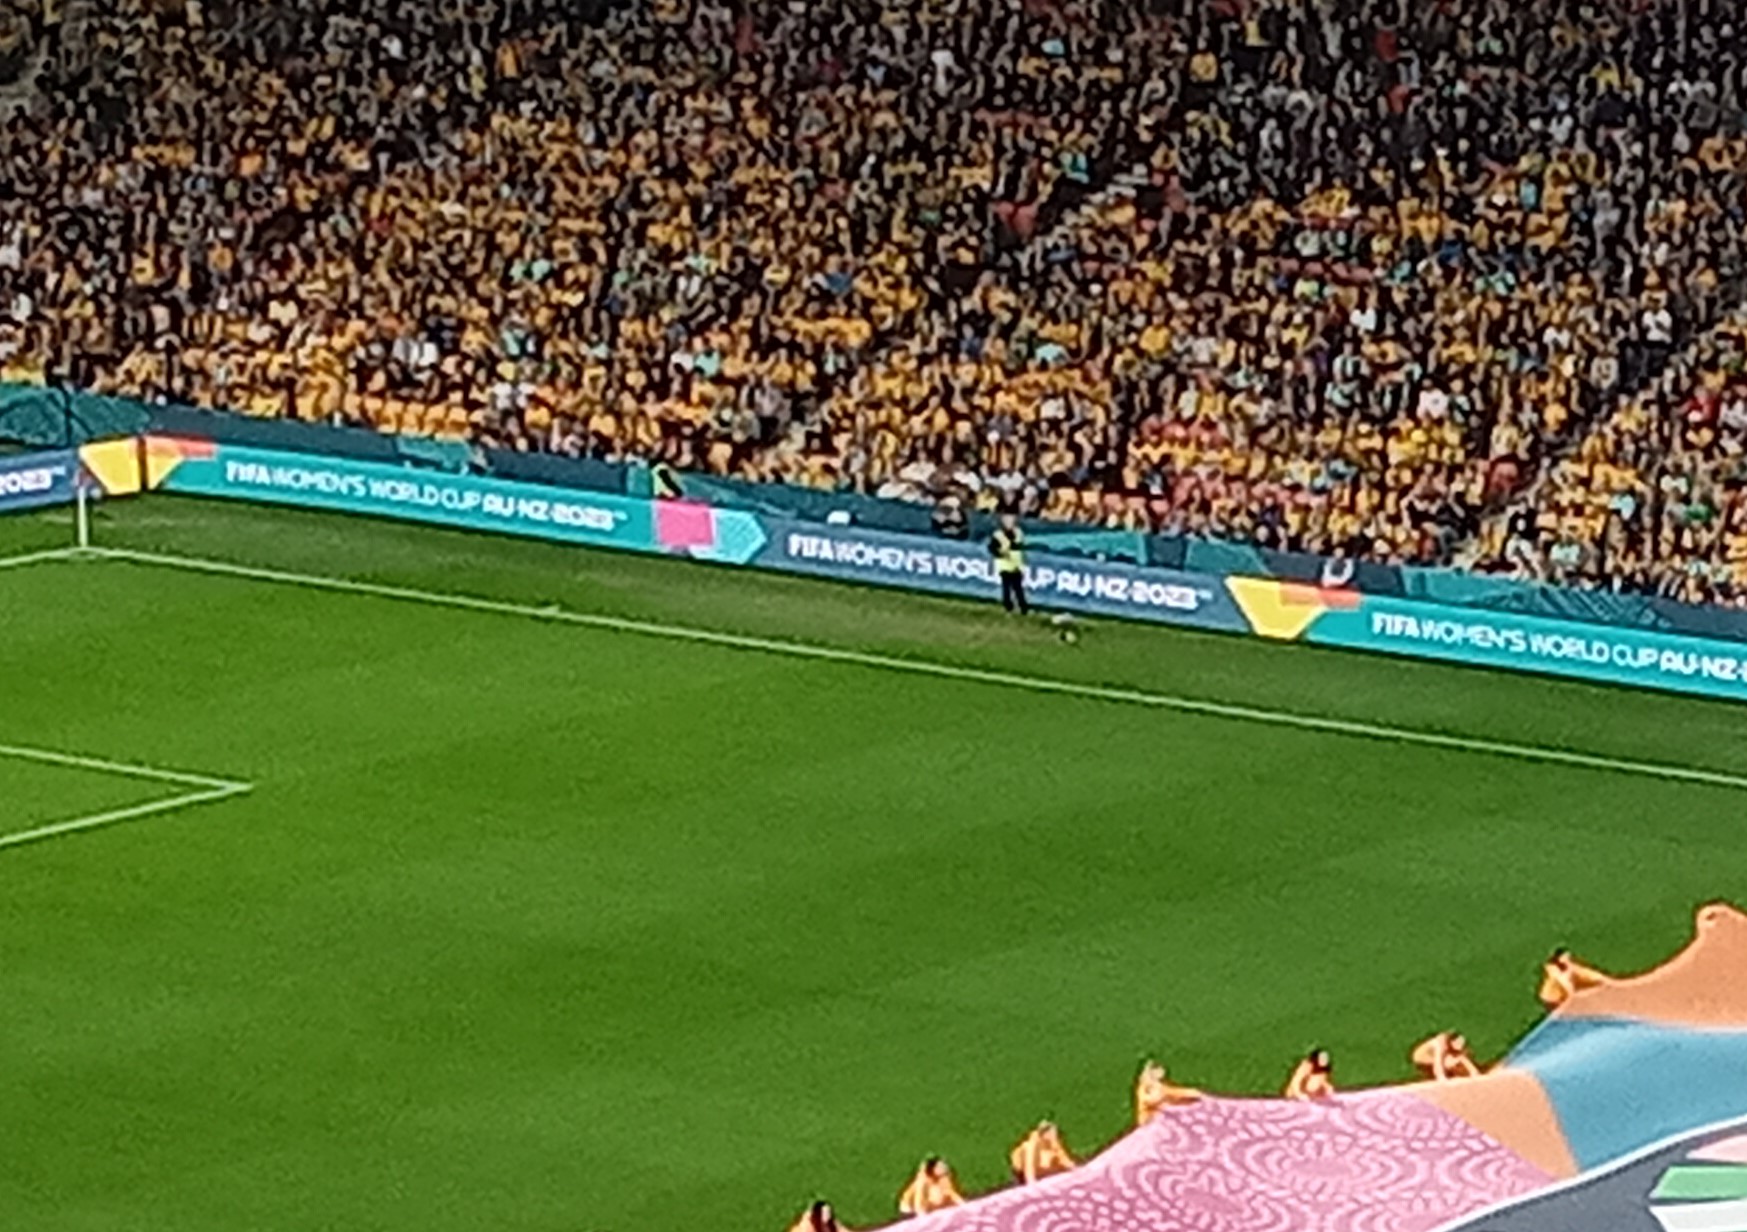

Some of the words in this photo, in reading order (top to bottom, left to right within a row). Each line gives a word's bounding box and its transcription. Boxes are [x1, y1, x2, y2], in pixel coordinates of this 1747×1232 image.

[226, 460, 270, 485] FIFA
[367, 478, 439, 507] WORLD
[441, 487, 481, 511] CUP
[788, 533, 833, 562] FIFA
[834, 541, 932, 575] WOMEN'S
[934, 555, 1002, 584] WORL
[1022, 565, 1055, 590] UP
[1371, 612, 1420, 637] FIFA
[1421, 619, 1526, 653] WOMEN'S
[1528, 631, 1610, 664] WORLD
[1612, 644, 1658, 669] CUP
